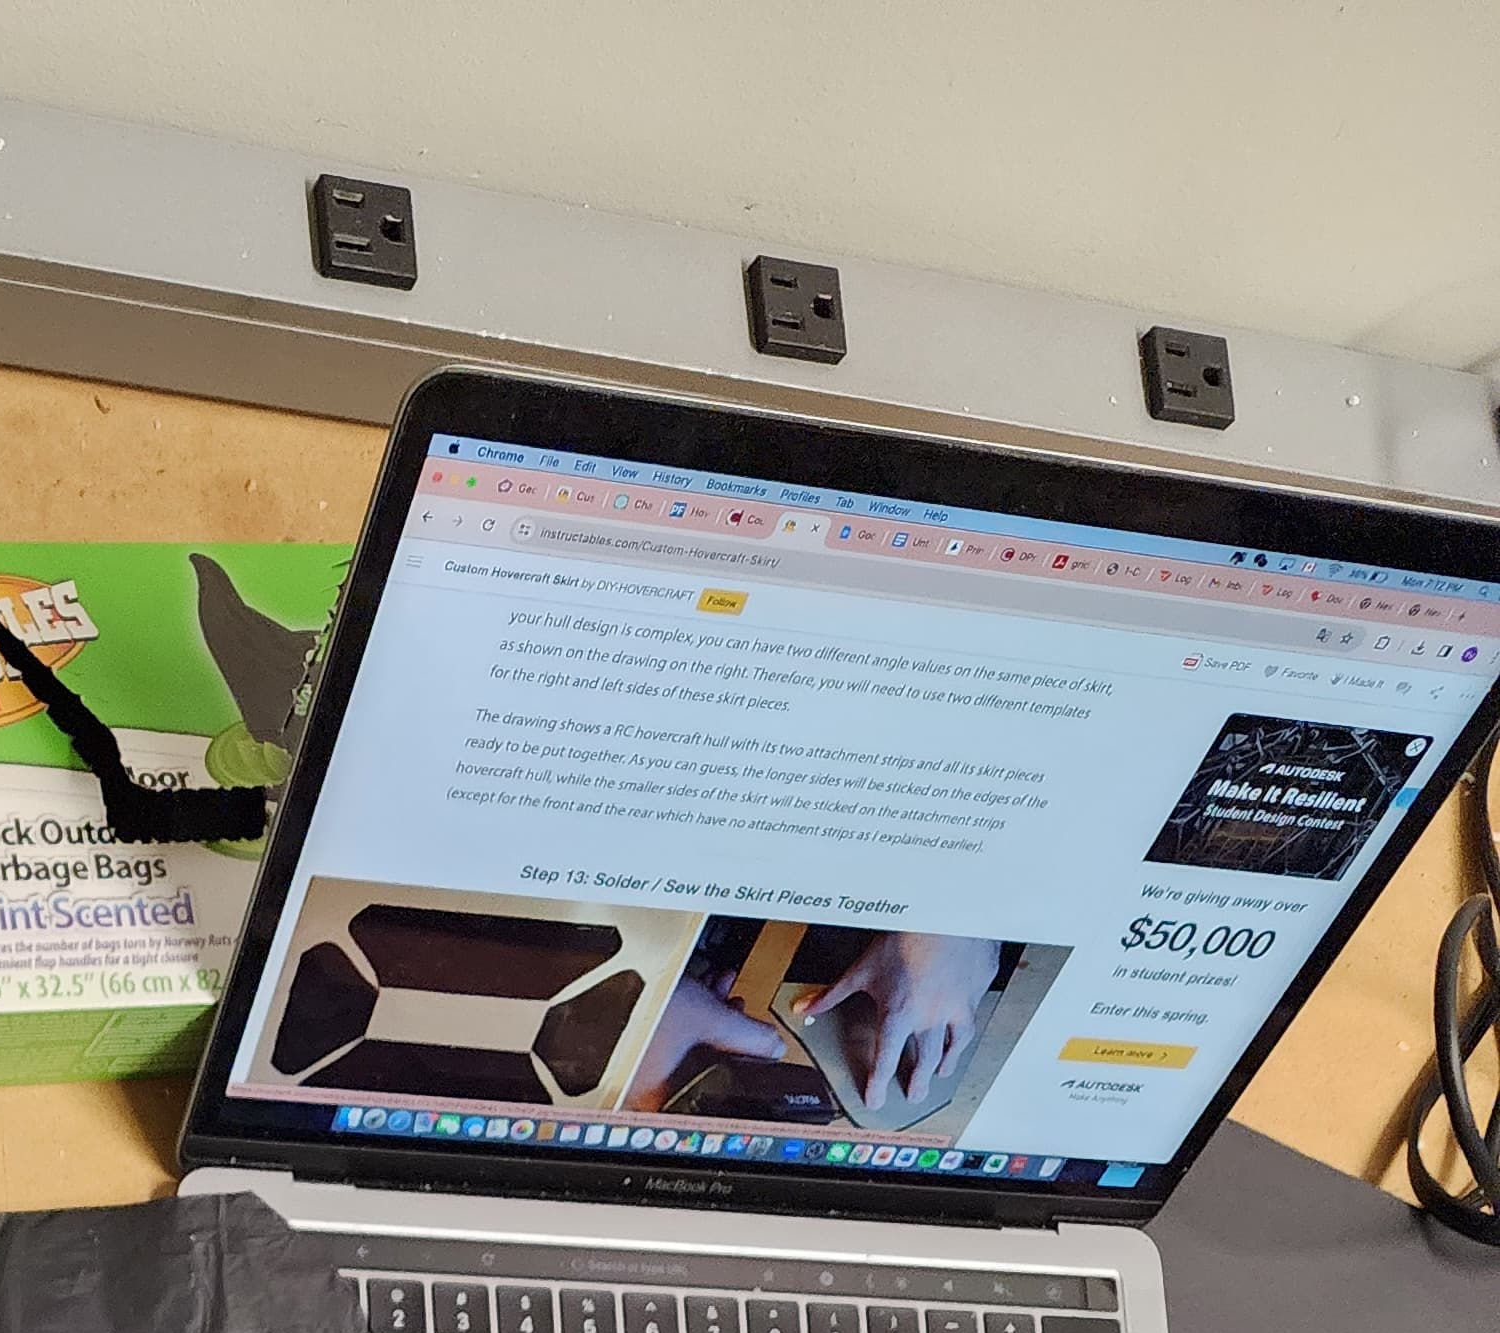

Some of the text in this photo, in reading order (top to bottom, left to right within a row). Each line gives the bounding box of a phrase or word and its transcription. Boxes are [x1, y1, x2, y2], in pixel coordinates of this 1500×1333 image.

[477, 446, 524, 463] Chrome
[573, 459, 596, 473] Edit
[612, 464, 639, 478] View
[651, 470, 693, 488] History
[705, 477, 767, 496] Bookmarks
[779, 488, 820, 504] Profiles
[835, 496, 854, 508] Tab
[868, 499, 911, 516] Window
[923, 508, 948, 522] Help
[444, 560, 488, 576] Custom
[490, 566, 550, 584] Hovercraft
[552, 574, 579, 587] Skirt
[580, 577, 595, 592] by
[507, 611, 1112, 696] your hull design is complex, you can have two different angle values on the same piece of skirt,
[499, 639, 1091, 719] as shown on the drawing on the right. Therefore, you will need to use two different templates
[475, 708, 1044, 783] The drawing shows a RC hovercraft hull with its two attachment strips and all its skirt pieces
[1275, 765, 1344, 781] AUTODESK
[1207, 779, 1365, 811] Make It Resilient
[1203, 803, 1344, 829] Student Design Contest
[94, 854, 167, 886] Bags
[519, 864, 559, 885] Step
[566, 869, 589, 884] 13:
[592, 871, 650, 890] Solder
[663, 878, 701, 895] Sew
[703, 882, 730, 898] the
[734, 885, 774, 902] Skirt
[776, 889, 832, 907] Pieces
[837, 895, 909, 914] Together
[1140, 883, 1308, 912] We're giving away over
[55, 892, 194, 928] Scented
[15, 941, 33, 952] the
[1120, 914, 1276, 959] $50,000
[18, 981, 31, 998] x
[101, 971, 136, 999] (66
[143, 975, 173, 993] cm
[180, 974, 191, 993] x
[1111, 964, 1238, 986] in student prizes!
[1089, 1001, 1208, 1025] Enter this spring.
[1076, 1079, 1143, 1092] AUTODESK
[392, 1309, 406, 1328] 2
[456, 1310, 470, 1332] 3
